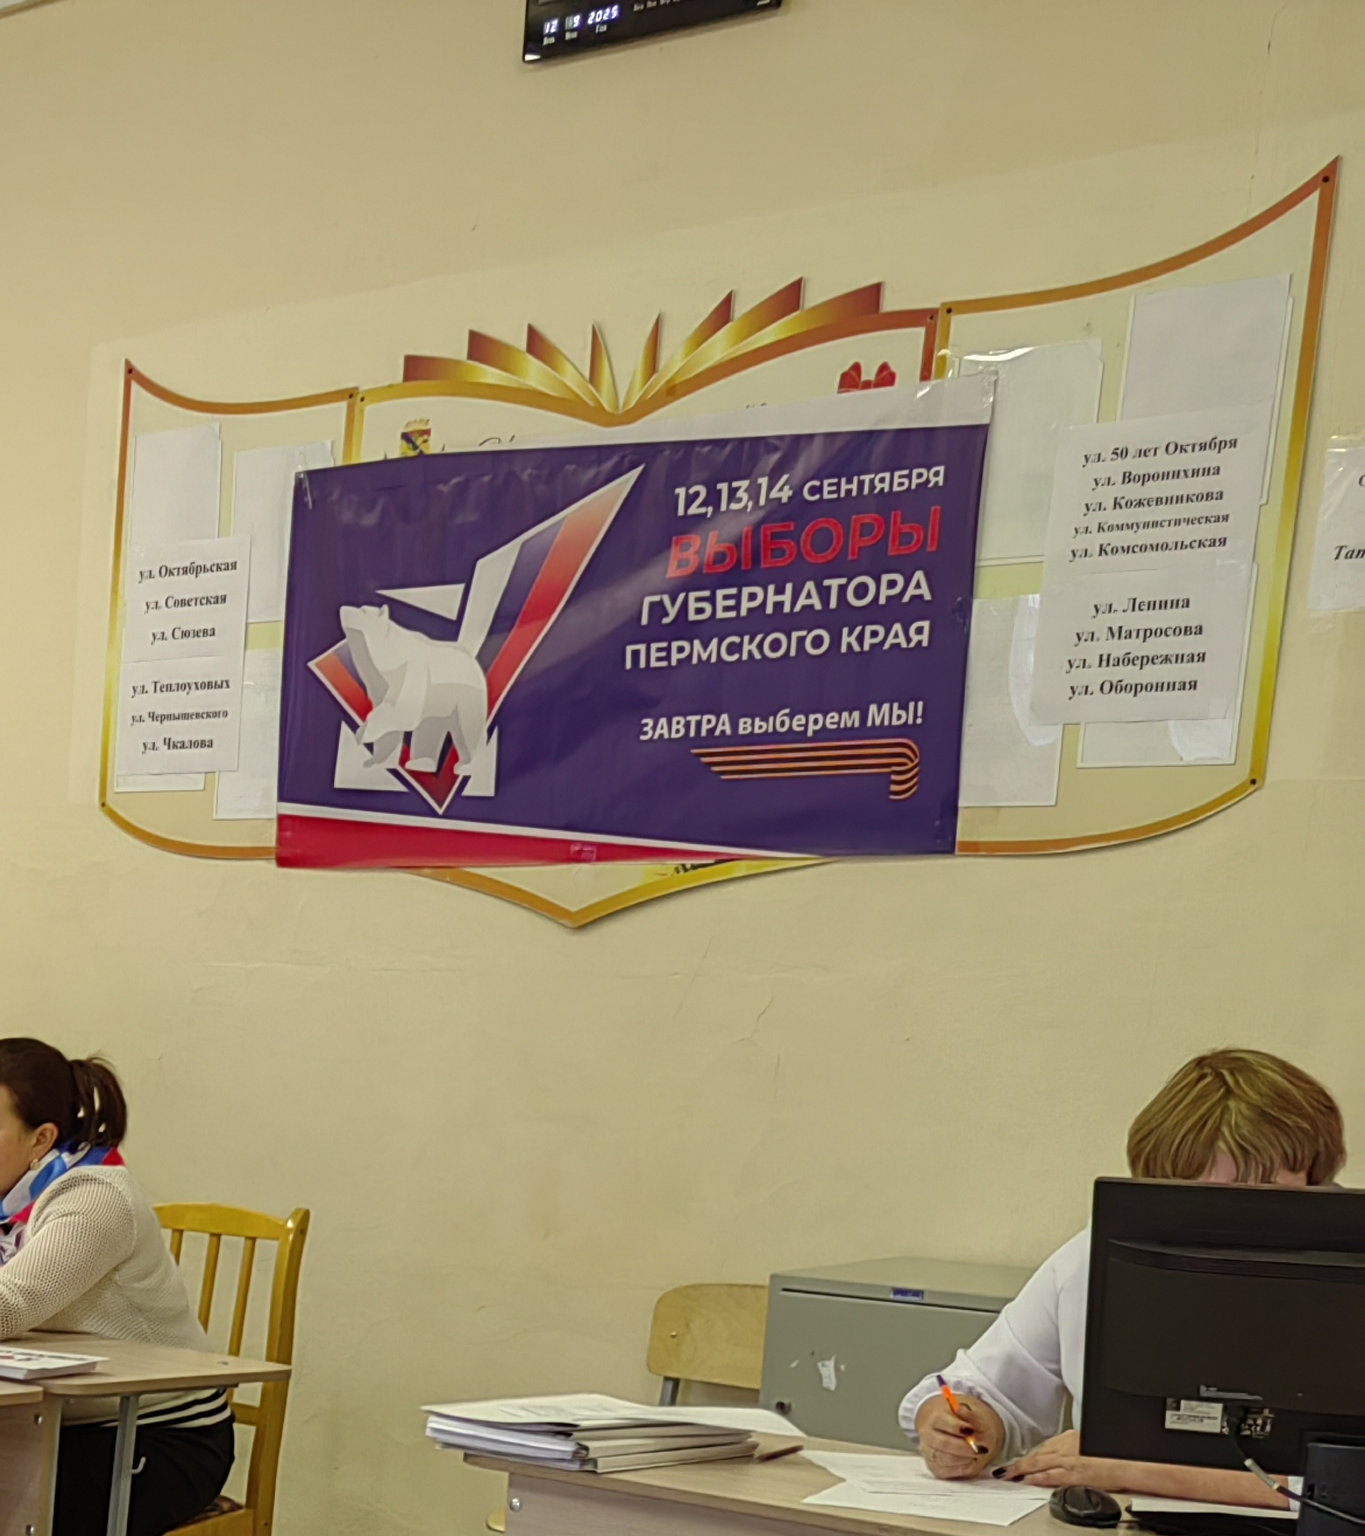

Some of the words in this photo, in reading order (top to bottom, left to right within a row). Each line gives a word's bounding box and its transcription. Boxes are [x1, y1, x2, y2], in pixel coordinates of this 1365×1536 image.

[587, 4, 619, 24] 2025
[1082, 453, 1106, 467] ул.
[1110, 447, 1129, 462] 50
[1132, 446, 1160, 459] лет
[1165, 436, 1238, 456] Октября
[1092, 475, 1116, 490] ул.
[1121, 465, 1221, 487] Воронихина
[674, 474, 793, 518] 12,13,14
[802, 465, 946, 501] СЕНТЯБРЯ
[1083, 501, 1107, 516] ул.
[1112, 490, 1224, 511] Кожевникова
[1072, 525, 1092, 539] ул.
[1097, 513, 1230, 533] Коммунистическая
[666, 505, 941, 578] ВЫБОРЫ
[1069, 547, 1093, 562] ул.
[1098, 536, 1228, 557] Комсомольская
[138, 570, 155, 584] ул.
[158, 560, 238, 579] Октябрьская
[144, 600, 162, 614] ул.
[165, 594, 227, 609] Советская
[640, 570, 932, 626] ГУБЕРНАТОРА
[1092, 603, 1118, 619] ул.
[1123, 597, 1191, 612] Ленина
[151, 630, 168, 645] ул.
[171, 626, 216, 640] Сюзева
[625, 628, 830, 670] ПЕРМСКОГО
[840, 620, 931, 654] КРАЯ
[1074, 631, 1100, 647] ул.
[1105, 624, 1203, 643] Матросова
[1066, 658, 1092, 674] ул.
[1098, 651, 1207, 671] Набережная
[131, 684, 149, 698] ул.
[151, 679, 230, 695] Теплоуховых
[1068, 684, 1094, 701] ул.
[1099, 679, 1198, 698] Оборонная
[130, 714, 145, 726] ул.
[148, 710, 229, 725] Чернышевского
[639, 713, 732, 741] ЗАВТРА
[737, 708, 860, 737] выберем
[866, 701, 924, 727] МЫ!
[142, 741, 159, 755] ул.
[163, 737, 214, 750] Чкалова
